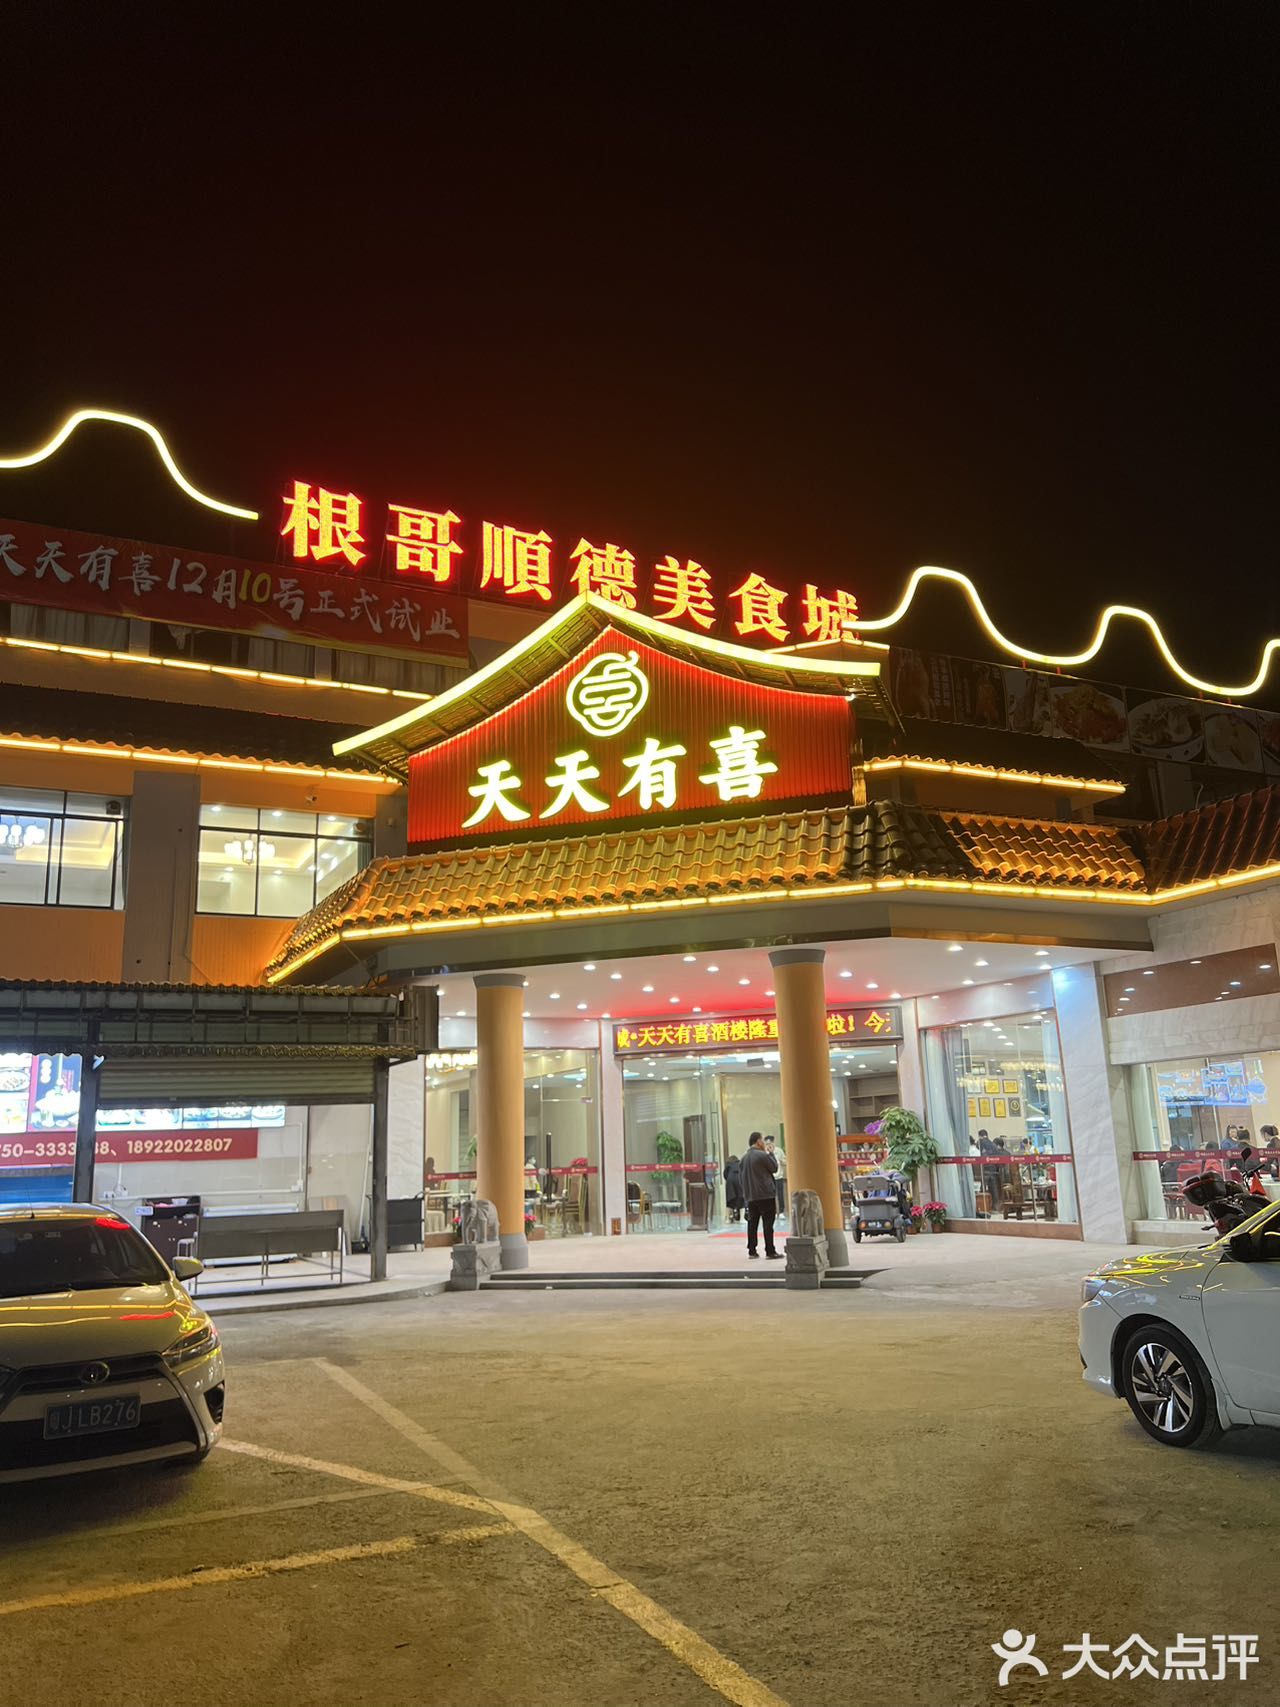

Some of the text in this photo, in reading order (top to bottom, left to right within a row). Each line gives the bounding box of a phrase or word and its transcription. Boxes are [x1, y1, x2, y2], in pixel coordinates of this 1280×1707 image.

[282, 480, 858, 641] 根哥順德美食城
[461, 726, 779, 830] 天天有喜
[127, 1138, 232, 1155] 18922022807
